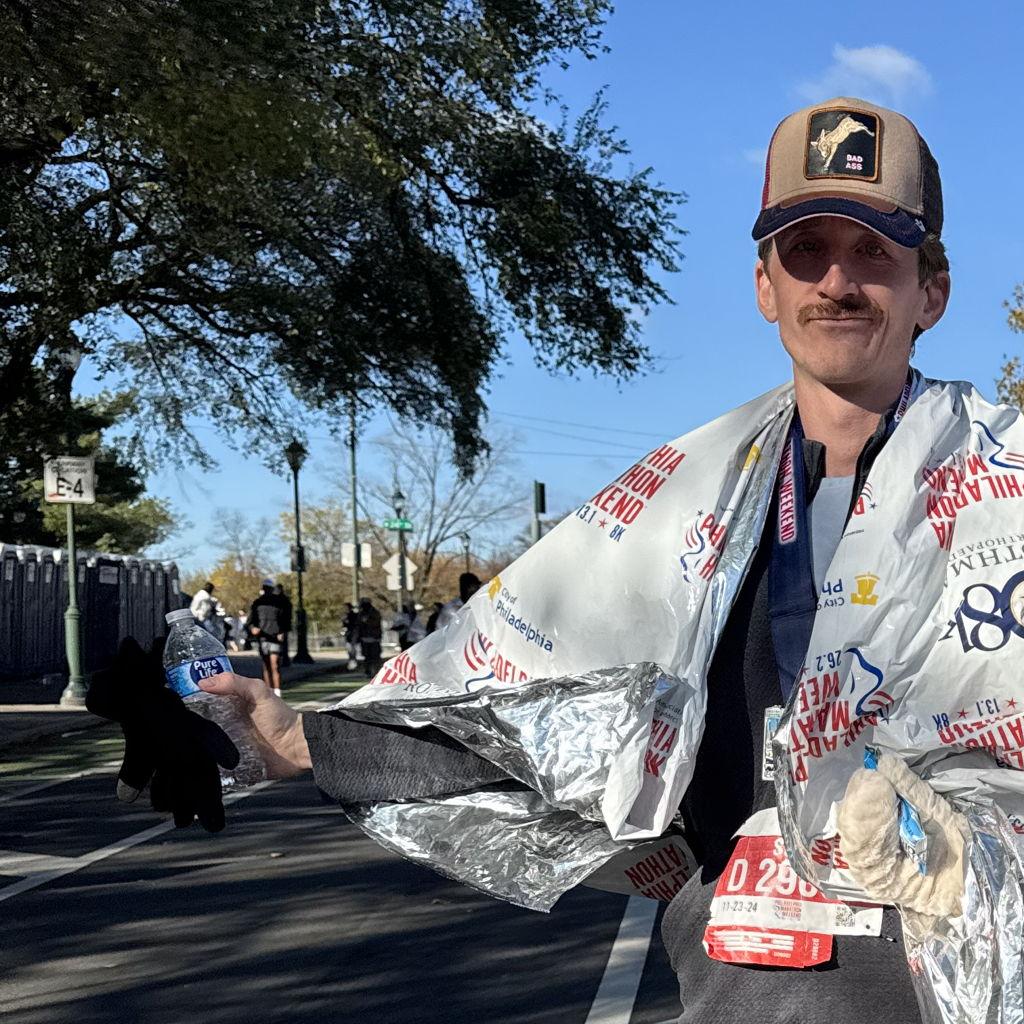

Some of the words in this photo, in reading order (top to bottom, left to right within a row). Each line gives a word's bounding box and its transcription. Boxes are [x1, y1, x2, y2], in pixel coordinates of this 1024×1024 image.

[846, 154, 863, 163] BAD
[846, 162, 863, 171] ASS
[780, 479, 795, 542] WEEKEND
[609, 524, 628, 543] 8K
[496, 600, 554, 652] Philadelphia
[193, 658, 217, 670] Pure
[815, 650, 842, 672] 26.2
[198, 668, 217, 679] Life
[932, 712, 950, 731] 8K
[975, 698, 1001, 717] 13.1
[727, 858, 749, 892] D
[722, 900, 758, 913] 11-23-24
